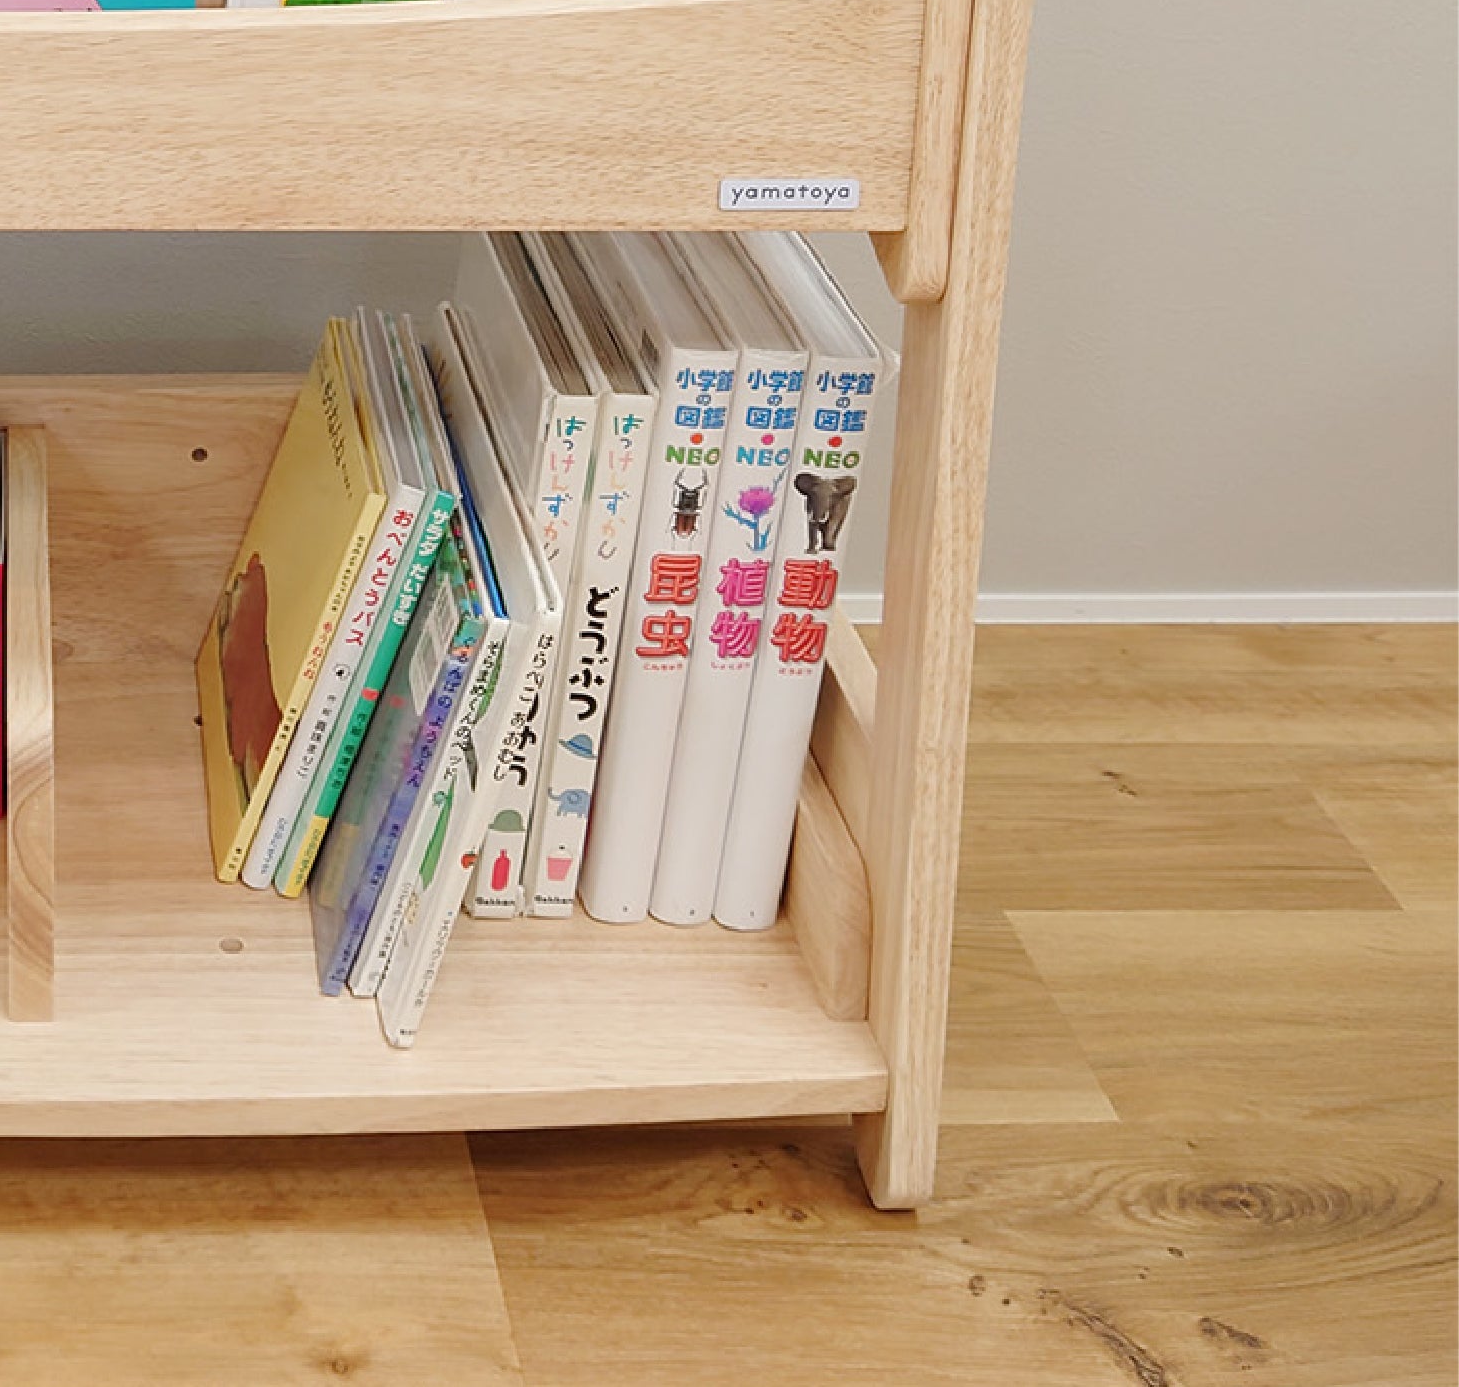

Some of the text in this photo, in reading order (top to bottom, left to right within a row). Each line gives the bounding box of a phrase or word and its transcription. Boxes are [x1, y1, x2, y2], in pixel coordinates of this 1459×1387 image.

[731, 185, 851, 206] yamatoya
[676, 368, 734, 392] 小学館
[747, 369, 804, 393] 小学館
[816, 371, 875, 395] 小学館
[696, 394, 712, 406] の
[767, 395, 782, 406] の
[835, 396, 851, 408] の
[675, 405, 727, 429] 図鑑
[746, 407, 797, 430] 図鑑
[815, 409, 867, 432] 図鑑
[666, 446, 721, 465] NEO
[737, 447, 791, 466] NEO
[803, 448, 861, 468] NEO
[346, 509, 414, 646] おべんとうバス
[635, 553, 703, 658] 昆虫
[710, 558, 769, 659] 植物
[771, 558, 838, 663] 動物
[569, 586, 620, 720] どうぶつ
[494, 634, 555, 783] はらぺこあおむし
